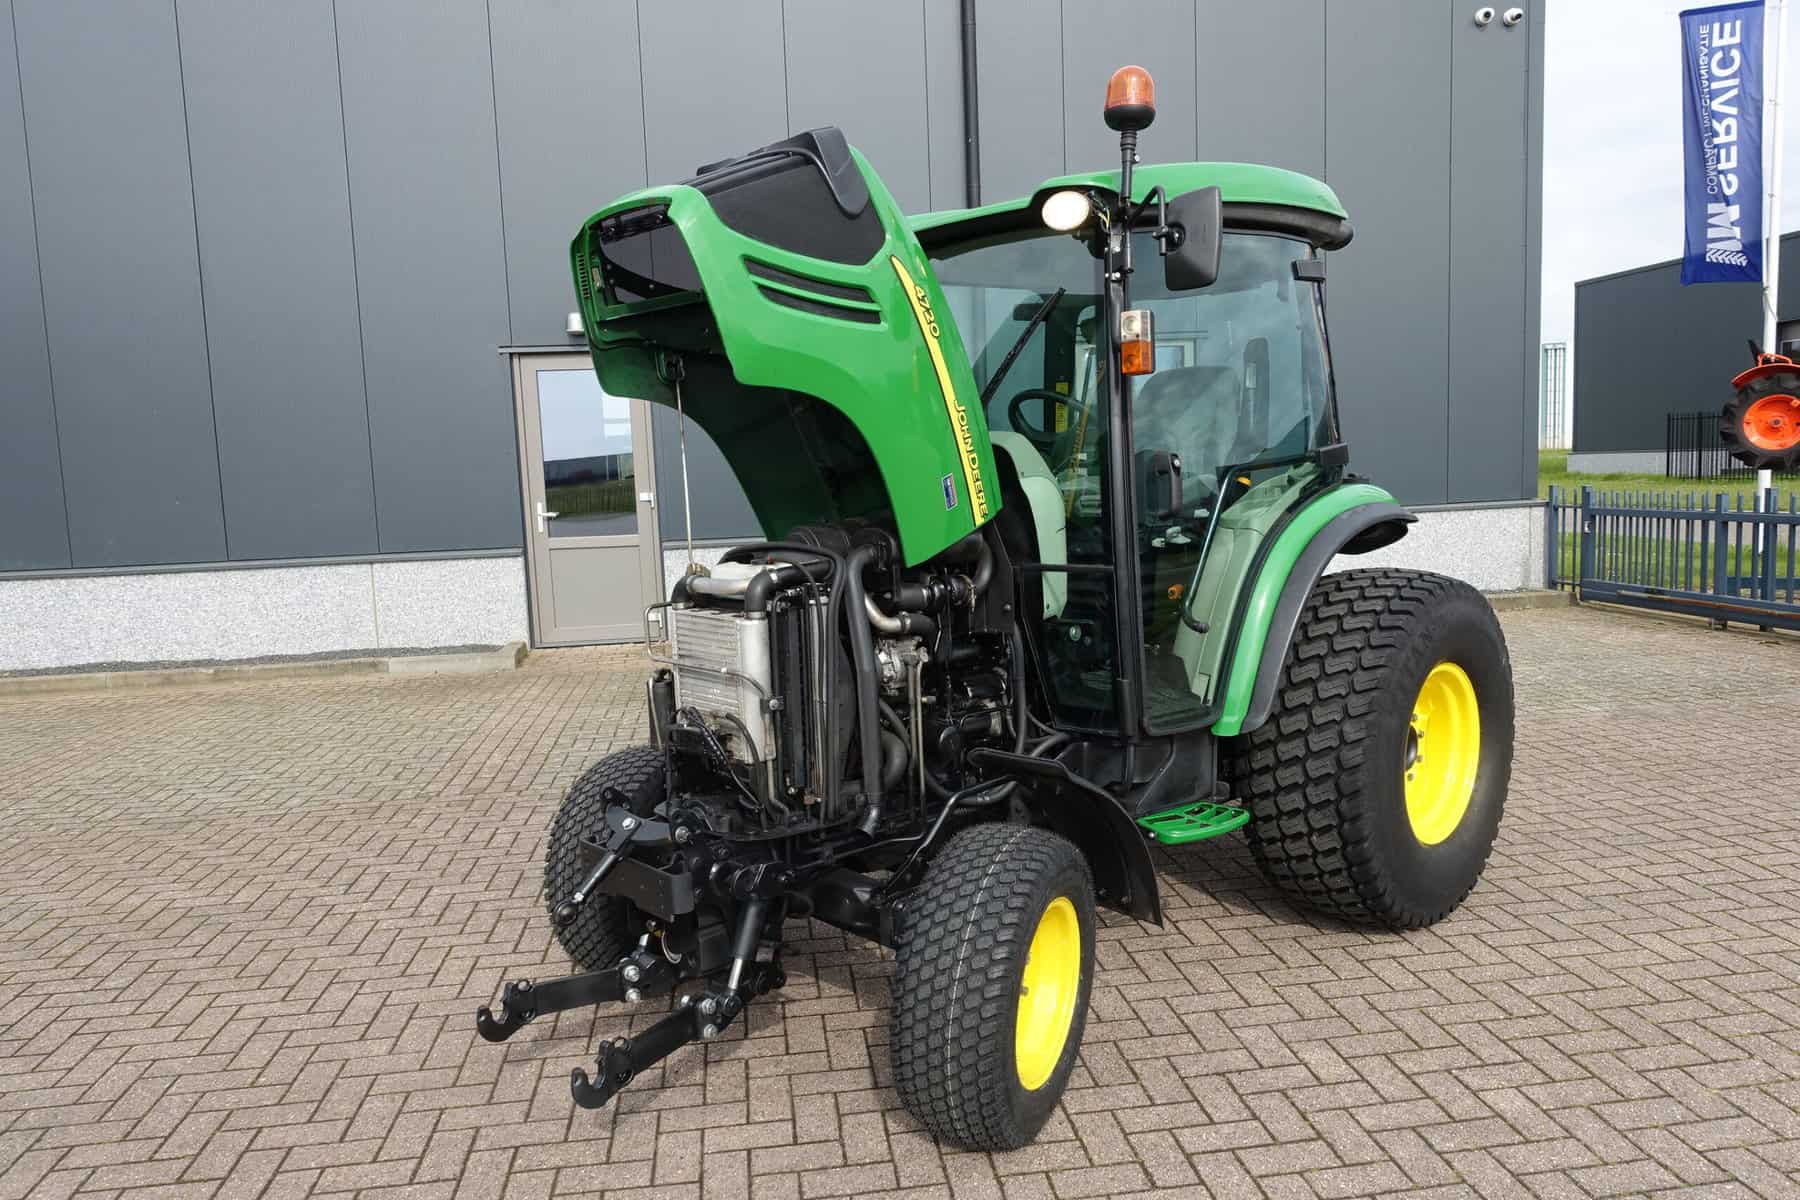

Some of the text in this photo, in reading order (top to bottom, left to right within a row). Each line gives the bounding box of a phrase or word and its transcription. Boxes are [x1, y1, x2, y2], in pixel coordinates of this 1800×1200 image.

[914, 284, 940, 339] 4720
[955, 400, 988, 517] JOHN DEERE
